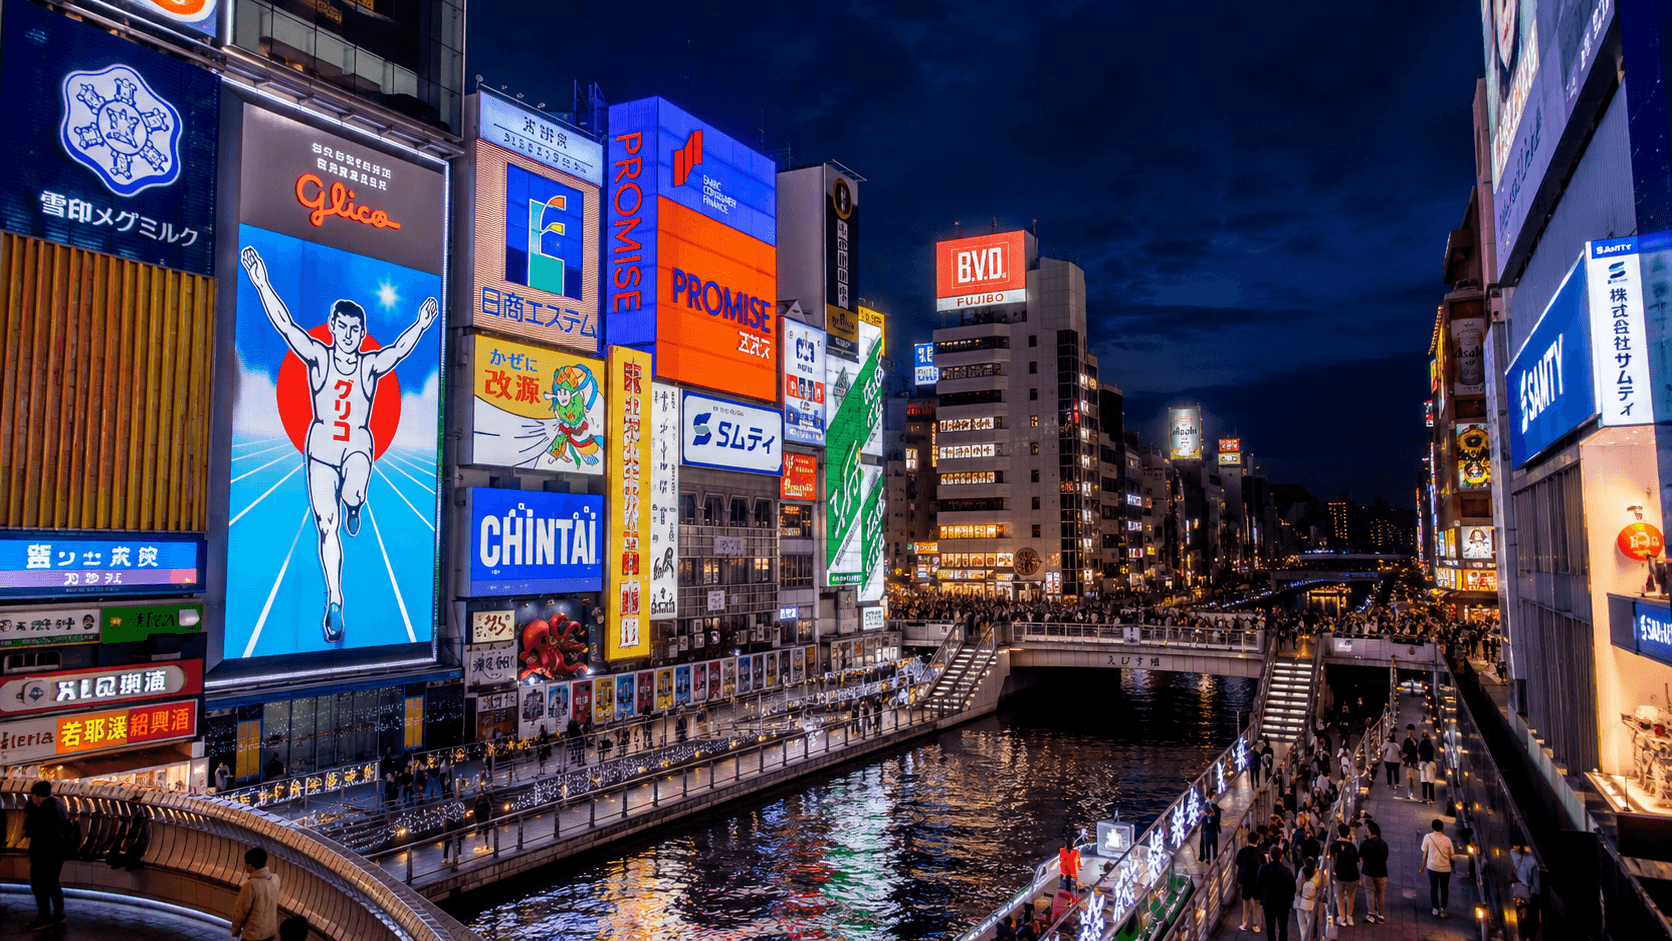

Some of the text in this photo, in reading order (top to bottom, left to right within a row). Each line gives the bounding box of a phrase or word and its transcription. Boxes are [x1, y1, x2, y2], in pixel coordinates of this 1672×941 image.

[41, 190, 198, 247] 雪印メグミルク
[295, 173, 401, 231] Glico
[614, 131, 643, 313] PROMISE
[958, 247, 1007, 283] B.V.D.
[481, 286, 597, 338] 日商エステム
[672, 267, 771, 333] PROMISE
[957, 293, 1004, 307] FUJIBO
[490, 348, 538, 372] かぜに
[1527, 333, 1564, 421] SAMTY
[1609, 287, 1634, 416] 株式会社サムティ
[333, 379, 354, 442] グリコ
[484, 369, 541, 404] 改源
[480, 510, 597, 567] CHINTAI
